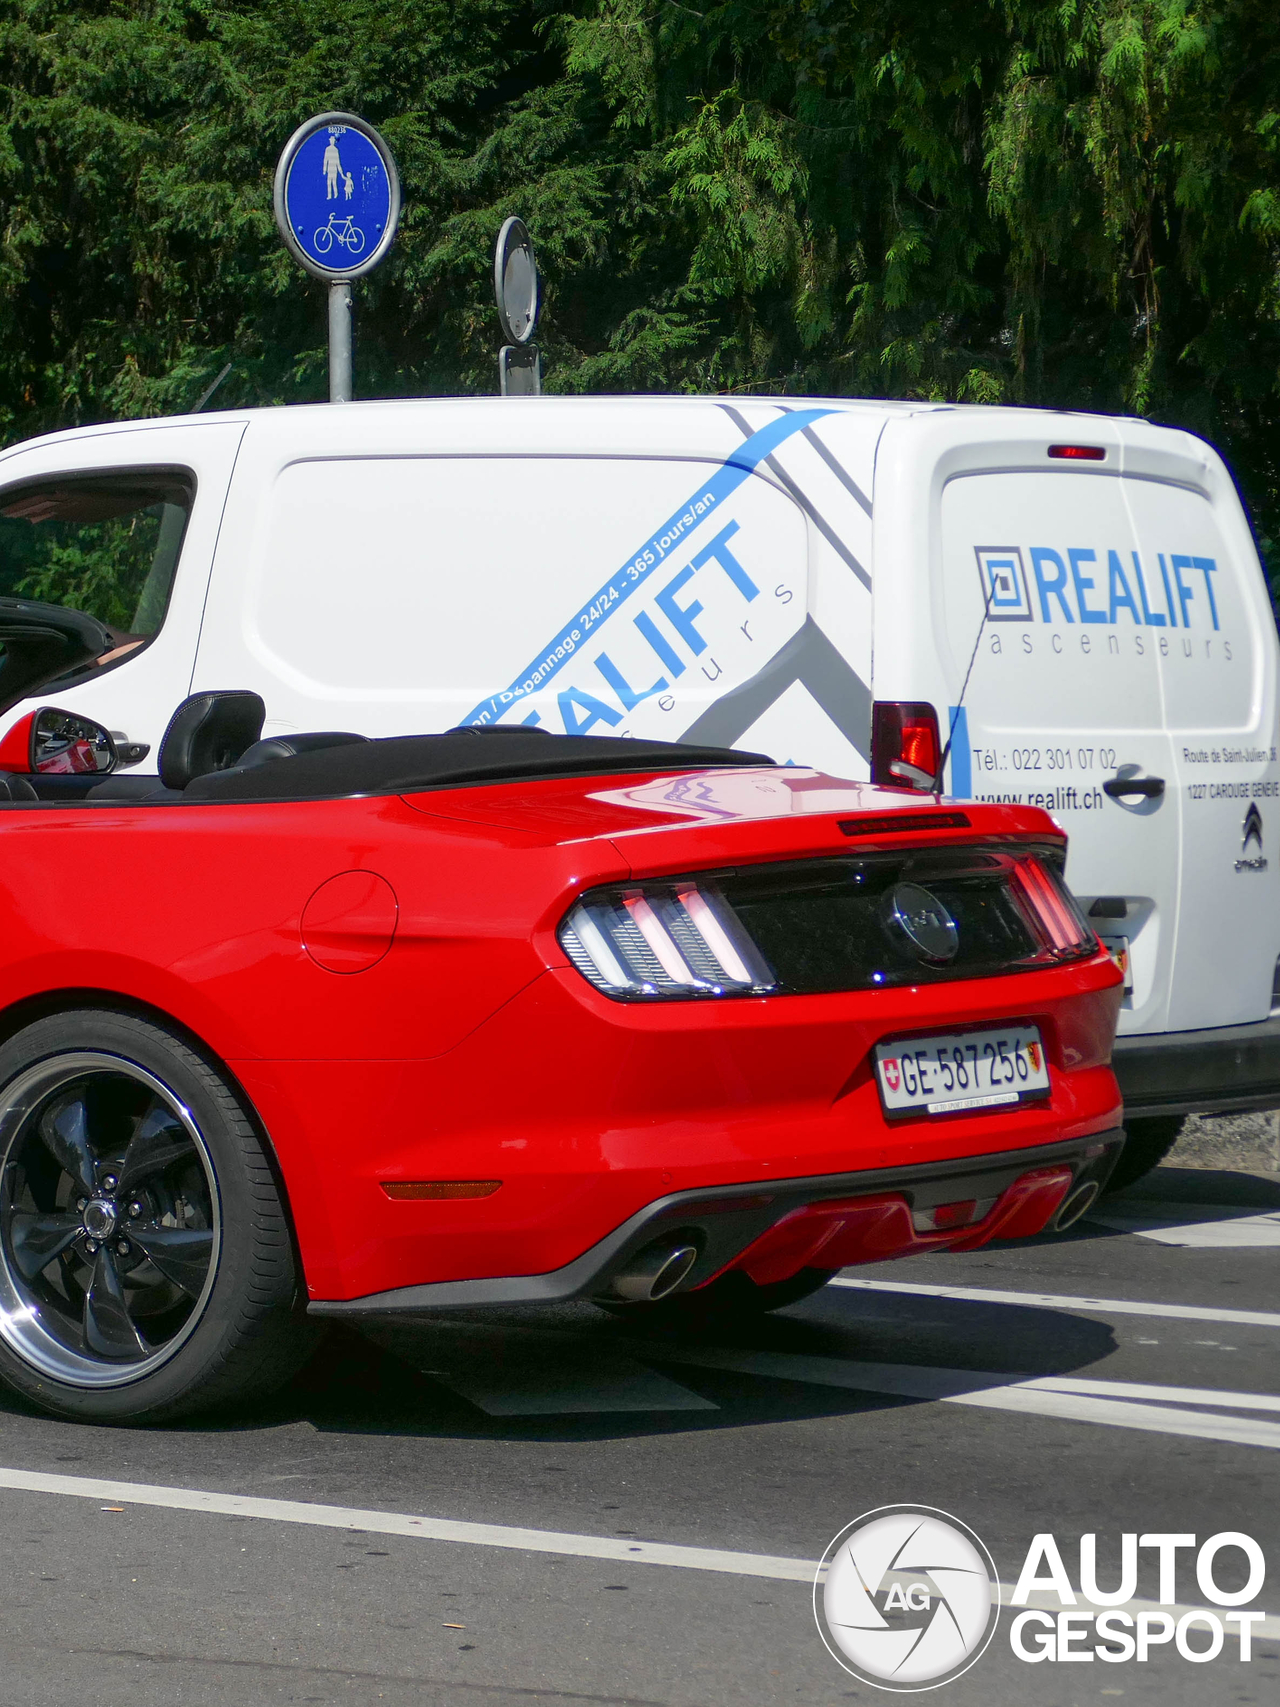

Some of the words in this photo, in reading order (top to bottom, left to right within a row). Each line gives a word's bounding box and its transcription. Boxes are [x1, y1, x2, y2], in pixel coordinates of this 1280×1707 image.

[499, 628, 581, 704] Dépannage
[579, 586, 620, 631] 24/24
[626, 549, 656, 581] 365
[653, 492, 716, 557] jours/an
[1029, 546, 1220, 631] REALIFT
[990, 633, 1232, 661] ascenseurs
[1012, 748, 1042, 770] 022
[1046, 748, 1073, 770] 301
[1078, 748, 1094, 770] 07
[1099, 748, 1118, 770] 02
[1183, 747, 1209, 763] Route
[1211, 748, 1221, 763] de
[1188, 783, 1207, 799] 1227
[1210, 783, 1250, 799] CAROUGE
